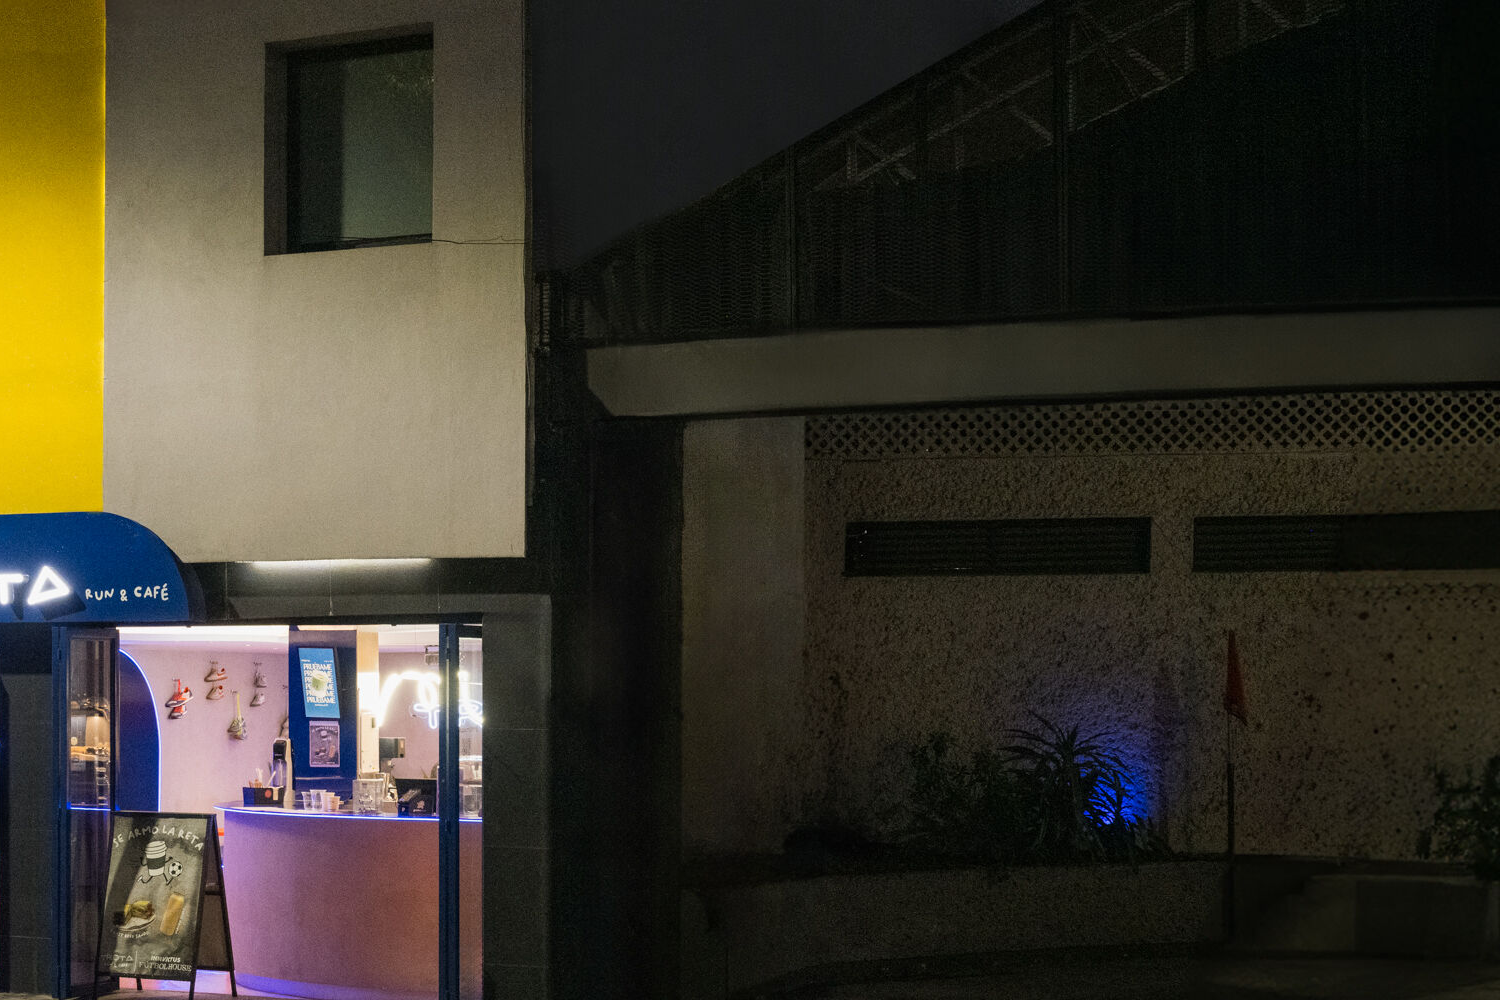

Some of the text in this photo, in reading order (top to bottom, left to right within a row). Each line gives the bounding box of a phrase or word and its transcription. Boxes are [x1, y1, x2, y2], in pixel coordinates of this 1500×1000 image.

[85, 588, 114, 601] RUN
[120, 589, 128, 601] &
[133, 583, 169, 601] CAFÉ
[113, 824, 204, 852] SE ARMO LA RETA
